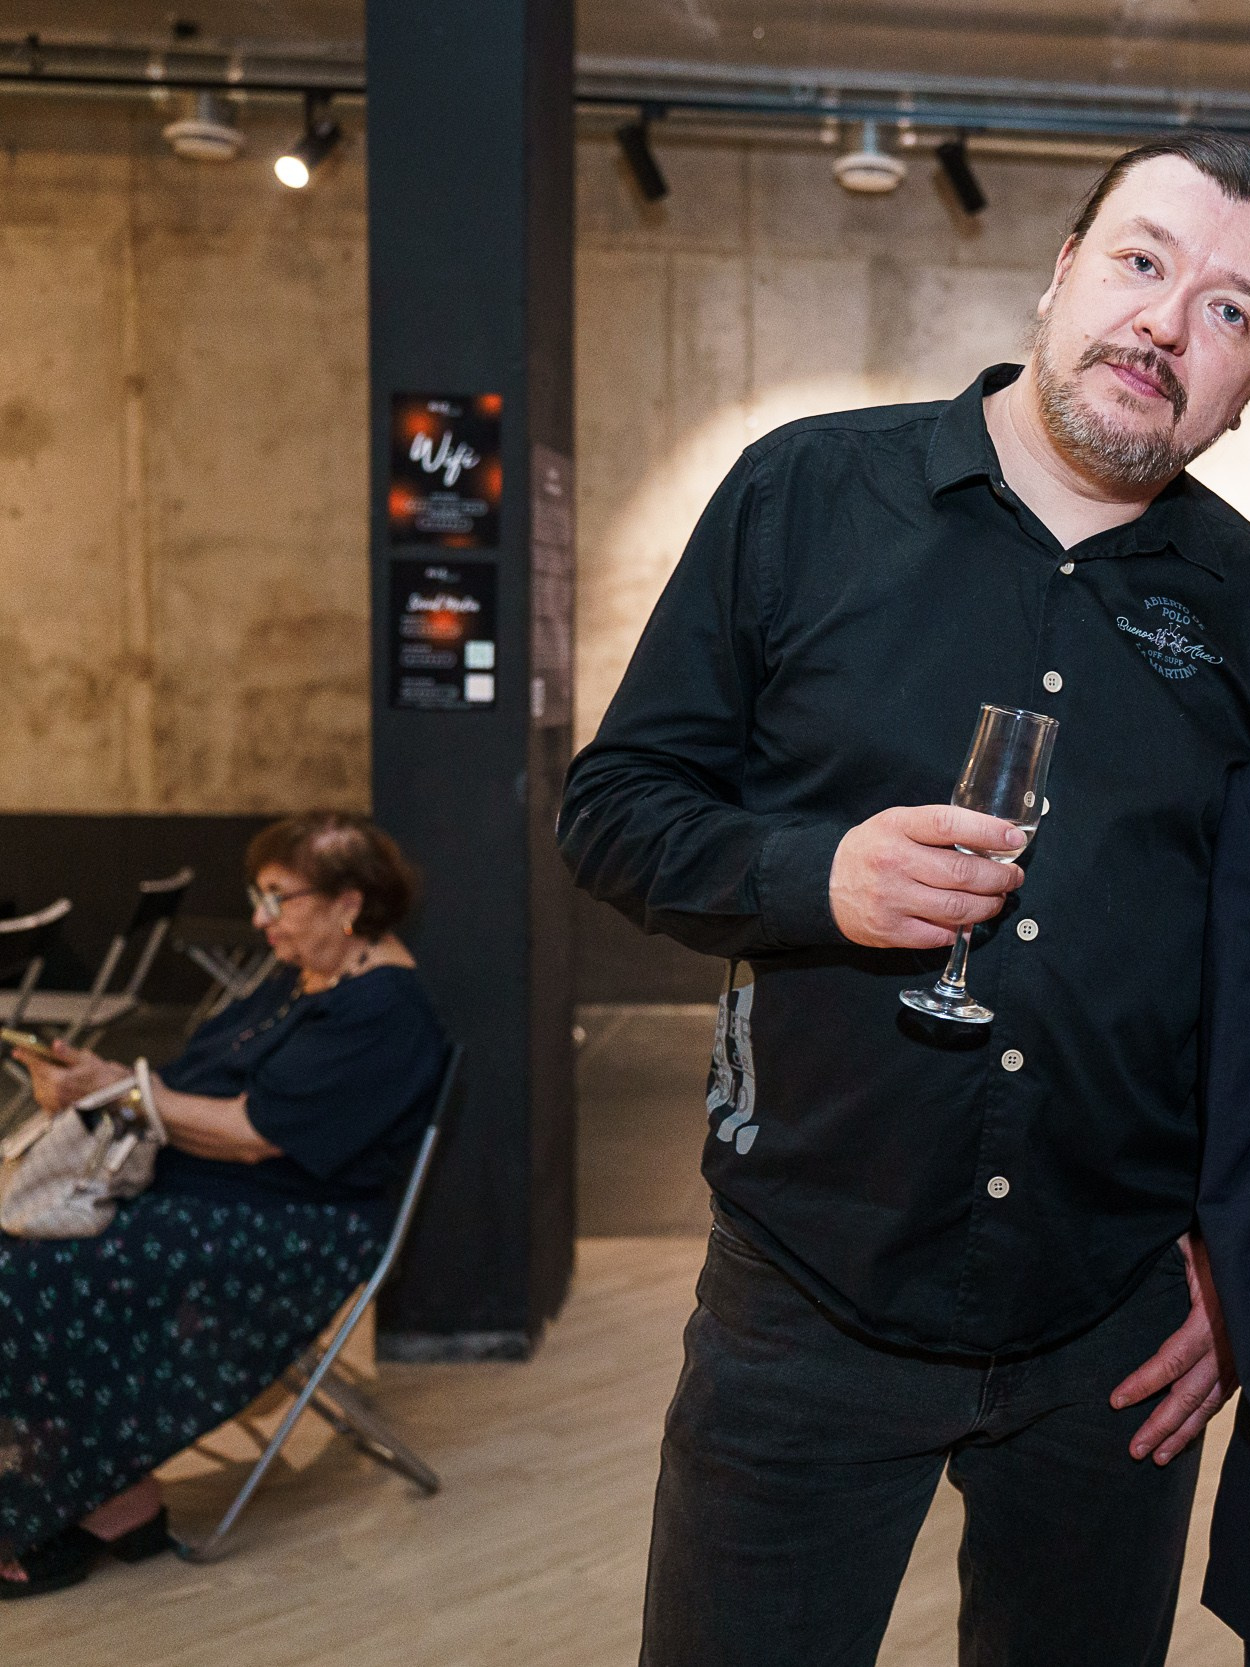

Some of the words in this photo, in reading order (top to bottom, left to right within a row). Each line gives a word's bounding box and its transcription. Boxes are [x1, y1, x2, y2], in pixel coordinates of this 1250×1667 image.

[1143, 596, 1190, 614] ABIERTO
[1162, 607, 1191, 625] POLO
[1116, 616, 1155, 642] Buenos
[1149, 658, 1198, 679] MARTINA
